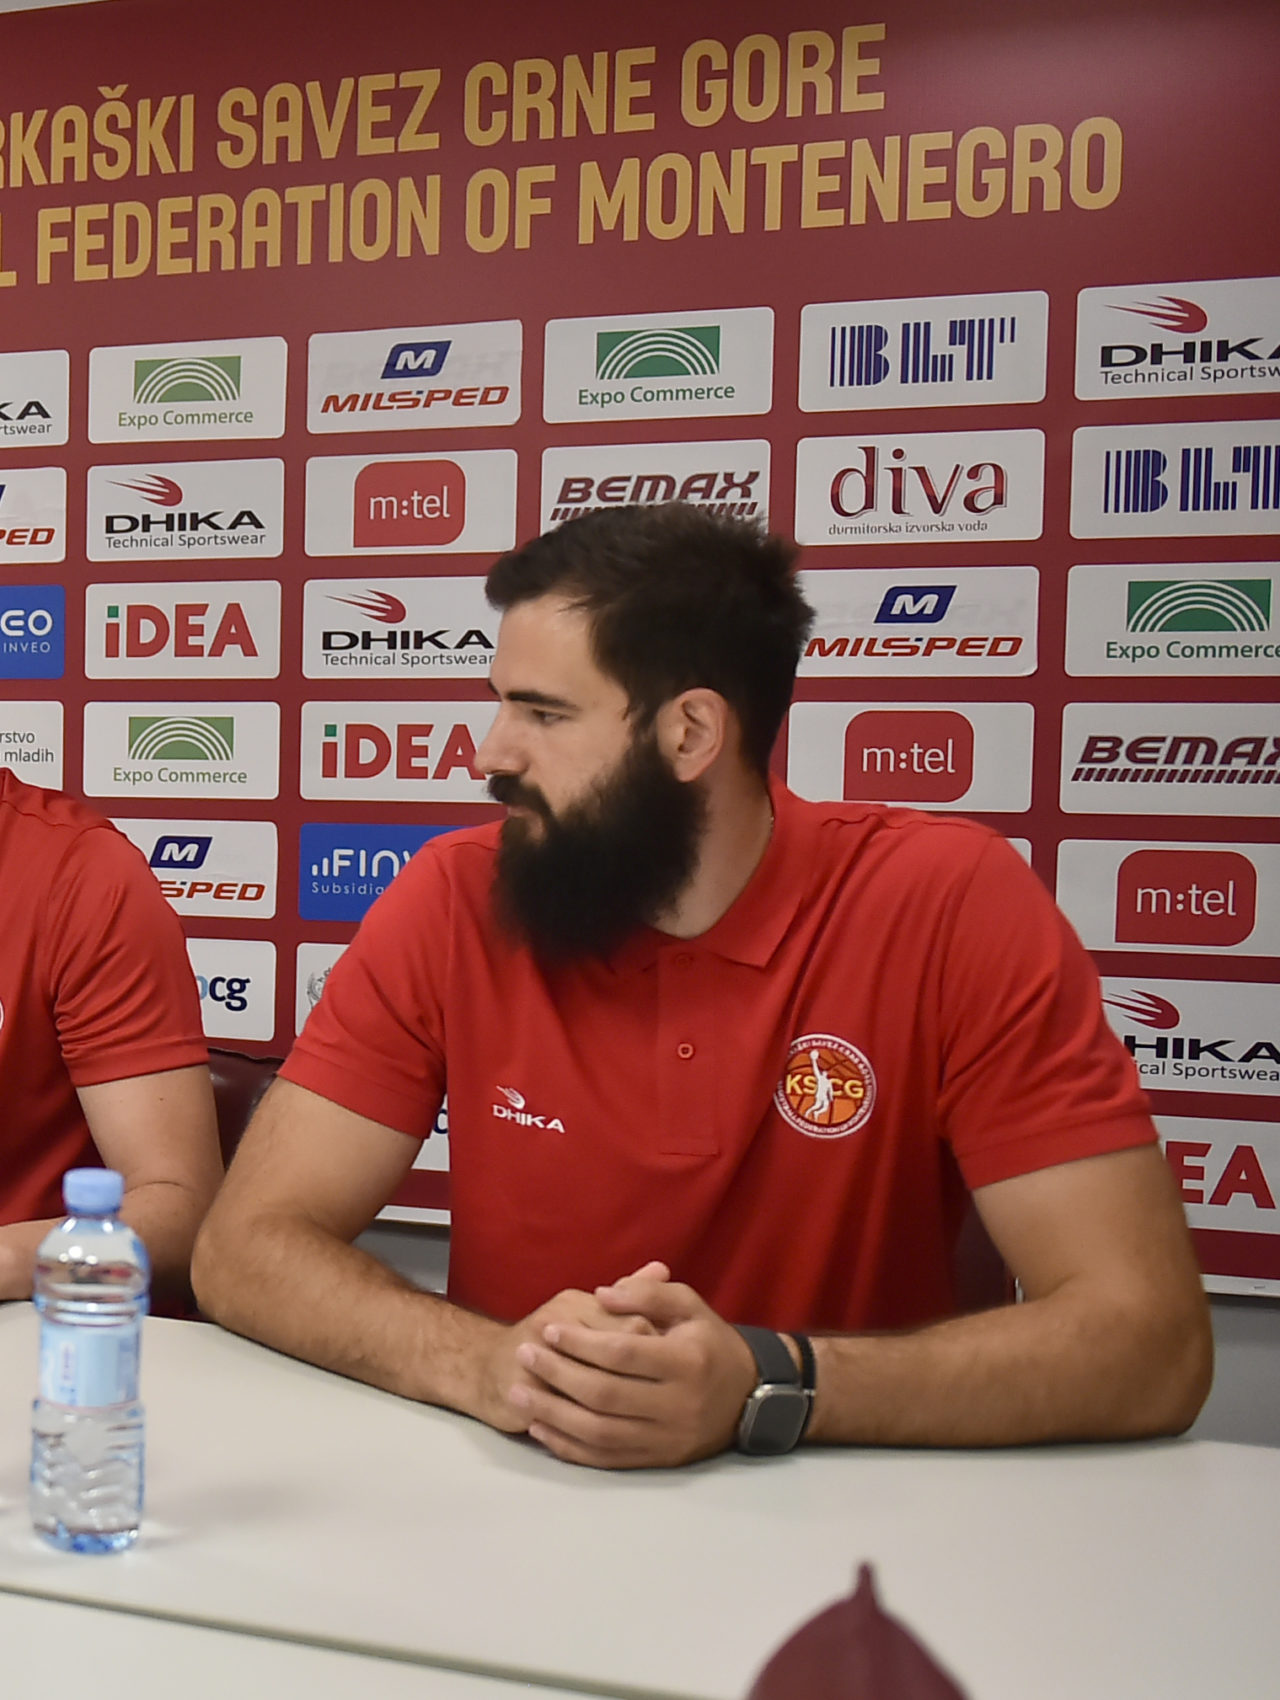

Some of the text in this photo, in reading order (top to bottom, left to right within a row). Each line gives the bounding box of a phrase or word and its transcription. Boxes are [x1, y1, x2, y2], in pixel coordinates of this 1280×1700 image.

[216, 68, 442, 169] SAVEZ
[463, 46, 656, 147] CRNE
[679, 22, 886, 128] GORE
[36, 173, 440, 285] FEDERATION
[464, 164, 556, 254] OF
[576, 115, 1124, 246] MONTENEGRO
[1100, 337, 1280, 368] DHIK
[1100, 364, 1280, 385] Technical Sportsw
[320, 385, 510, 414] MILSPED
[578, 383, 736, 408] Expo Commerce
[118, 408, 254, 430] Expo Commerce
[557, 471, 760, 503] BEMAX
[829, 446, 1008, 519] diva
[368, 486, 450, 520] m:tel
[105, 510, 264, 533] DHIKA
[958, 519, 988, 532] voda
[105, 531, 266, 549] Technical Sportswear
[105, 603, 259, 658] iDEA
[322, 630, 495, 650] DHIKA
[4, 641, 51, 653] INVEO
[804, 637, 1022, 657] MILSPED
[1106, 641, 1160, 662] Expo
[322, 652, 495, 668] Technical Sportswear
[4, 748, 54, 762] mladih
[322, 723, 487, 780] iDEA
[862, 738, 955, 773] m:tel
[113, 766, 248, 785] Expo Commerce
[333, 848, 411, 877] FIN
[159, 881, 266, 901] SPED
[311, 882, 385, 895] Subsidia
[1136, 880, 1236, 916] m:tel
[1124, 1035, 1280, 1064] HIKA
[1172, 1063, 1280, 1082] Sportswea
[492, 1105, 565, 1134] DHIKA
[1164, 1140, 1276, 1209] EA
